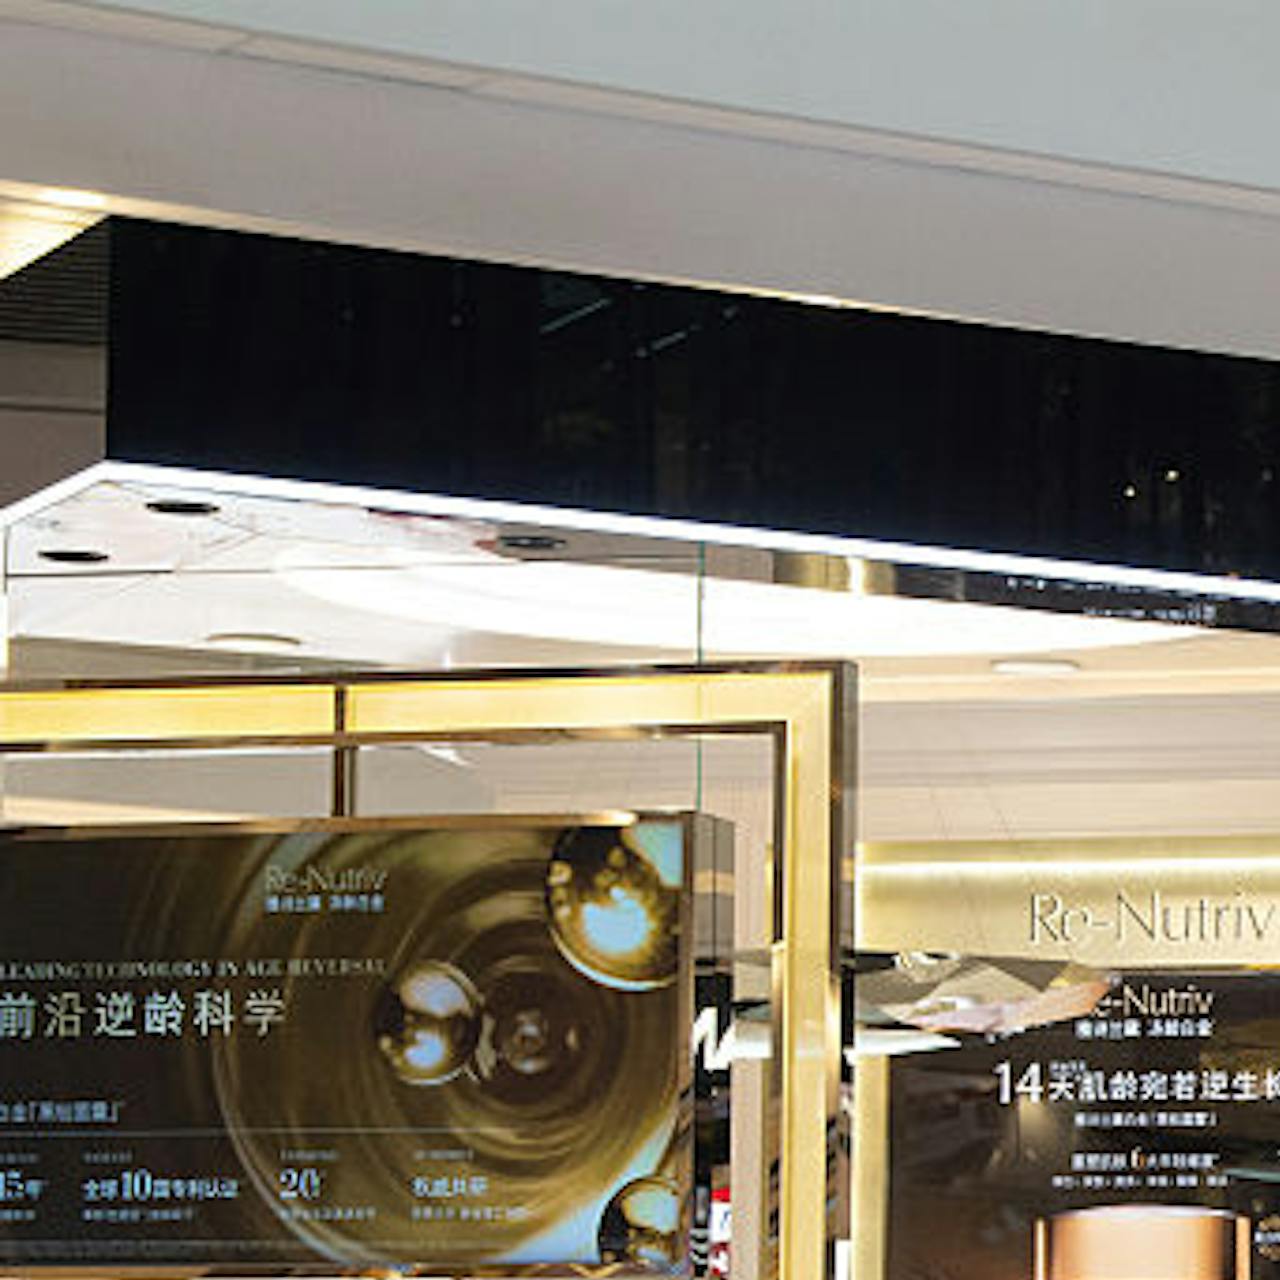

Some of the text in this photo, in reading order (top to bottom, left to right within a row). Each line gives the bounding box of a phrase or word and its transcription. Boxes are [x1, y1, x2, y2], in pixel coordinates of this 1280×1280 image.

[1030, 890, 1275, 943] Re-Nutriv
[0, 988, 287, 1039] 前沿逆龄科学
[1093, 983, 1214, 1017] e-Nutriv
